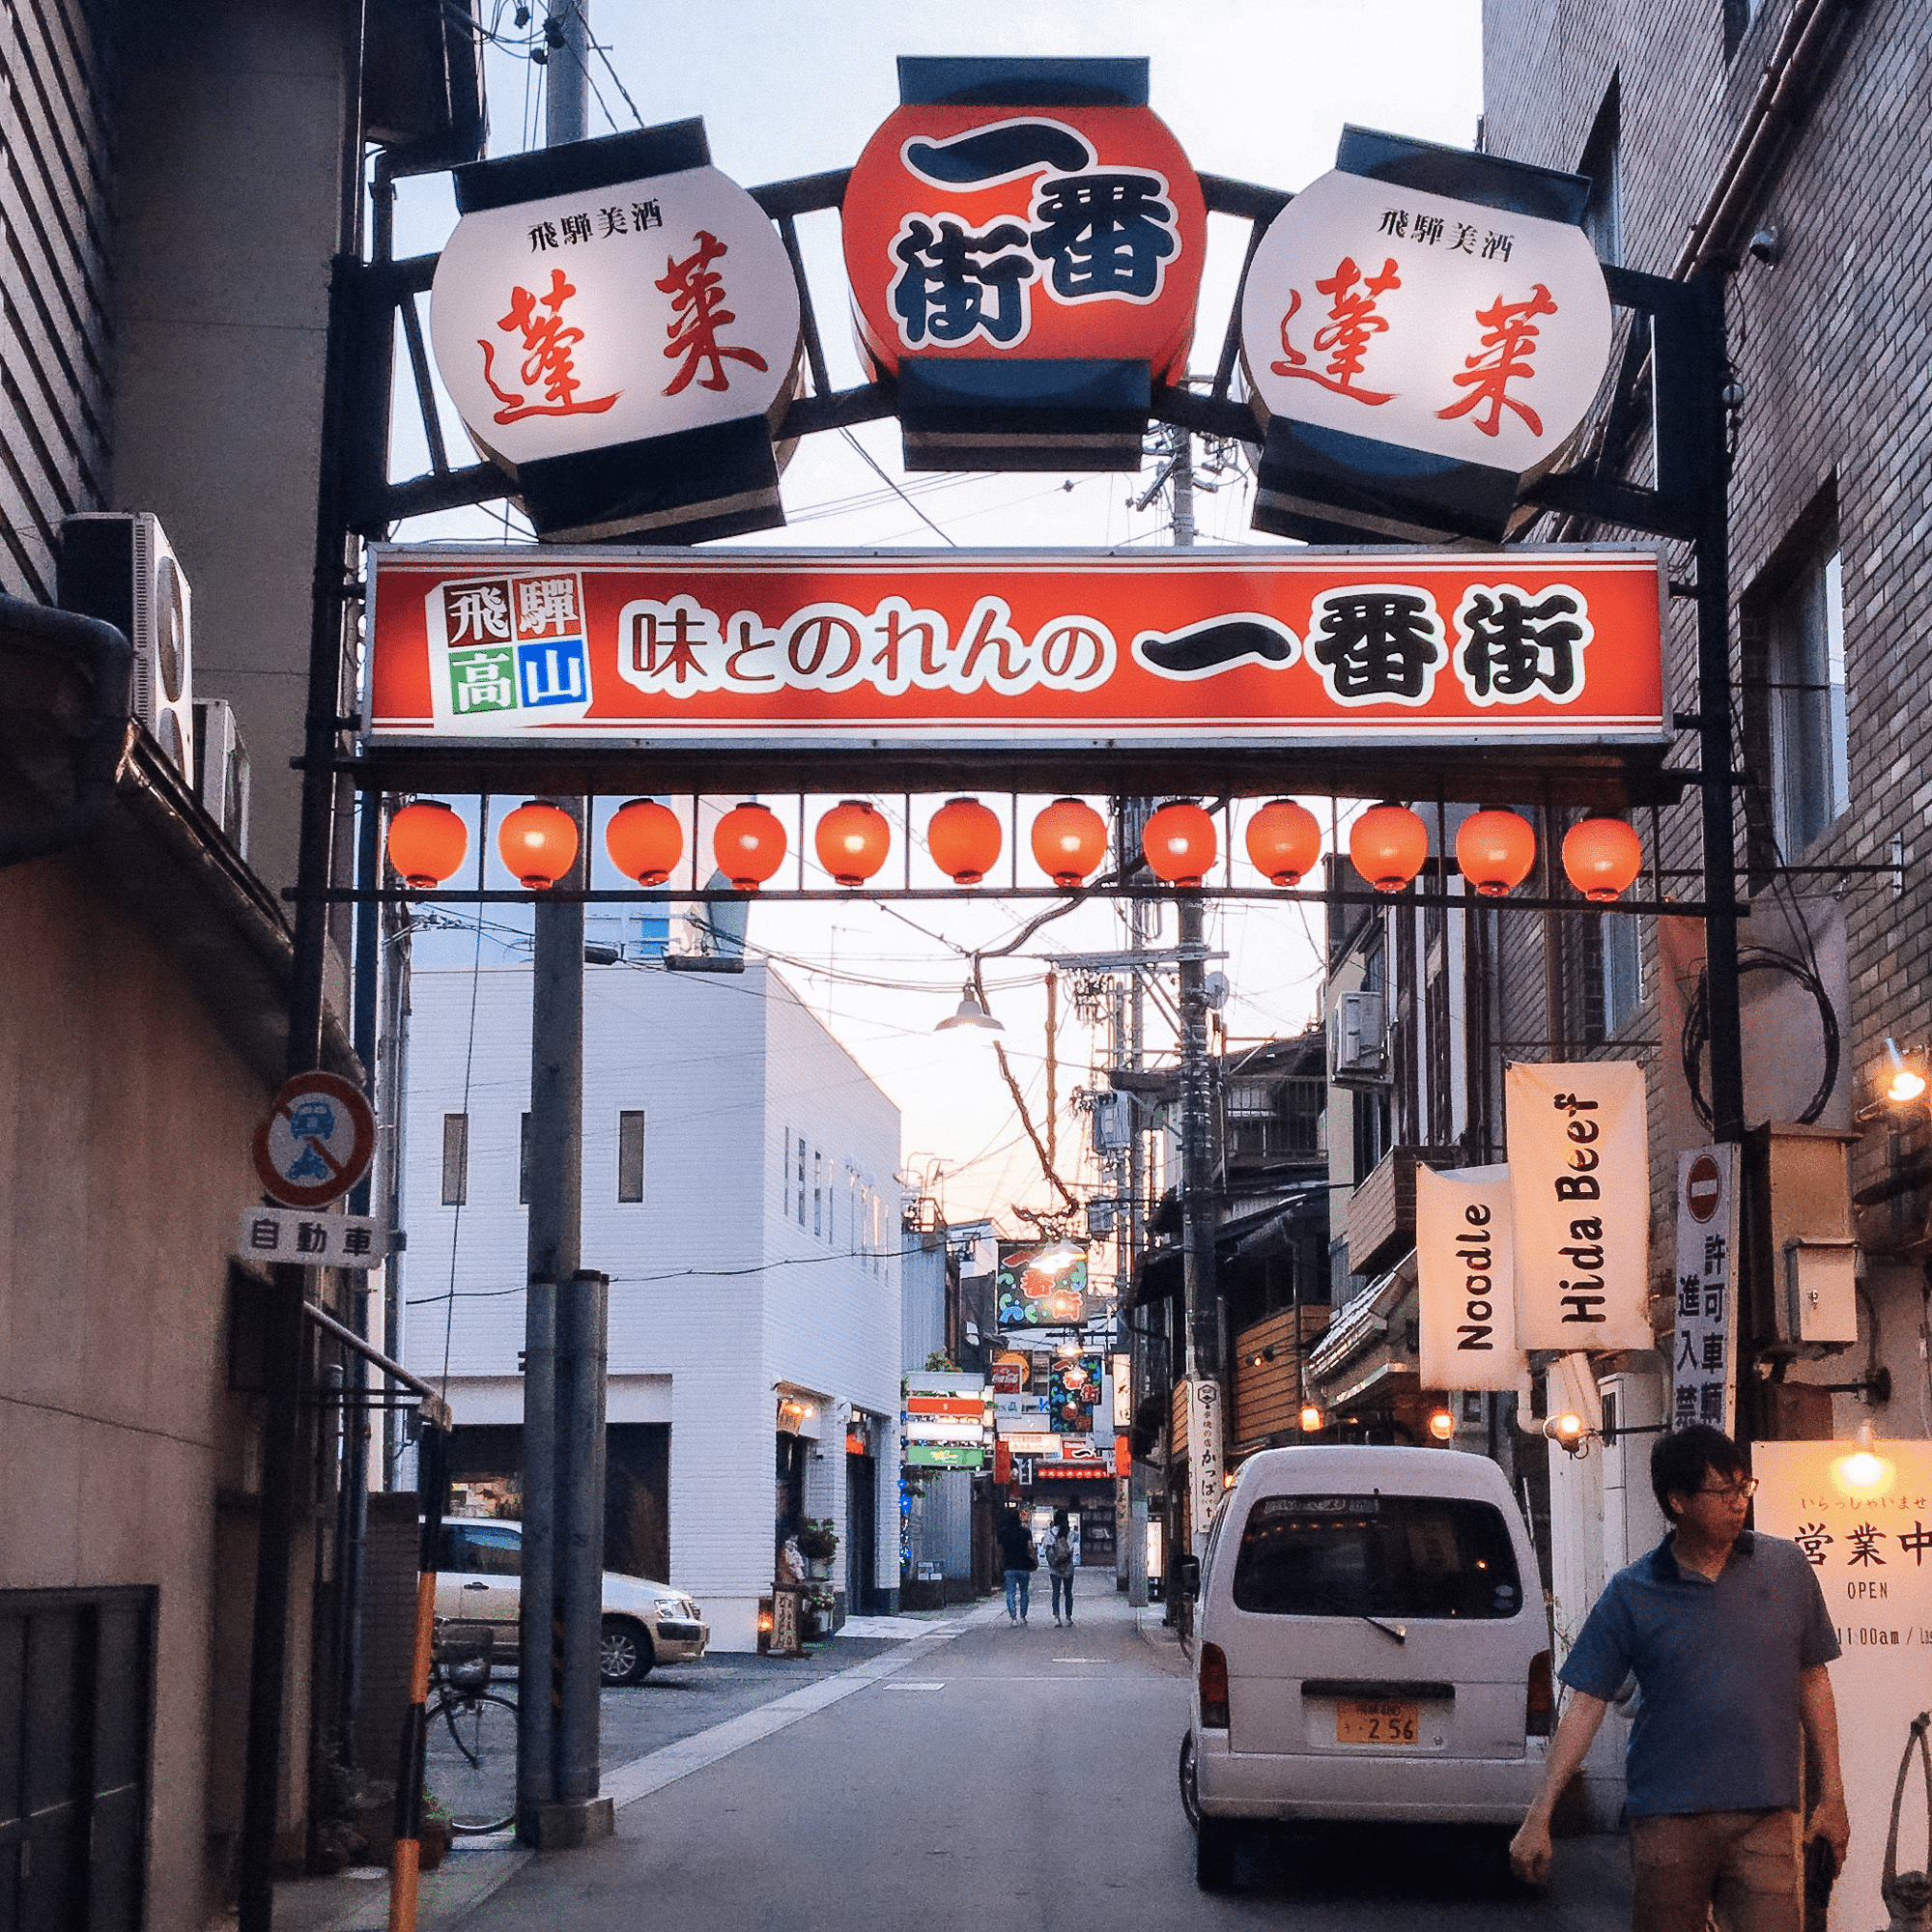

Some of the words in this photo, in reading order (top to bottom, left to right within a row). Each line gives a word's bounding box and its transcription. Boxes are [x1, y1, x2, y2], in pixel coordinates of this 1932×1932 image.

[893, 121, 1177, 345] 一番街
[452, 648, 582, 713] 高山
[1553, 1092, 1602, 1203] Beef
[250, 1218, 374, 1257] 自動車
[1558, 1215, 1607, 1324] Hida
[1455, 1203, 1493, 1351] Noodle
[1801, 1495, 1927, 1512] いらっしゃいませ
[1794, 1520, 1932, 1567] 営業中
[1847, 1581, 1889, 1600] OPEN
